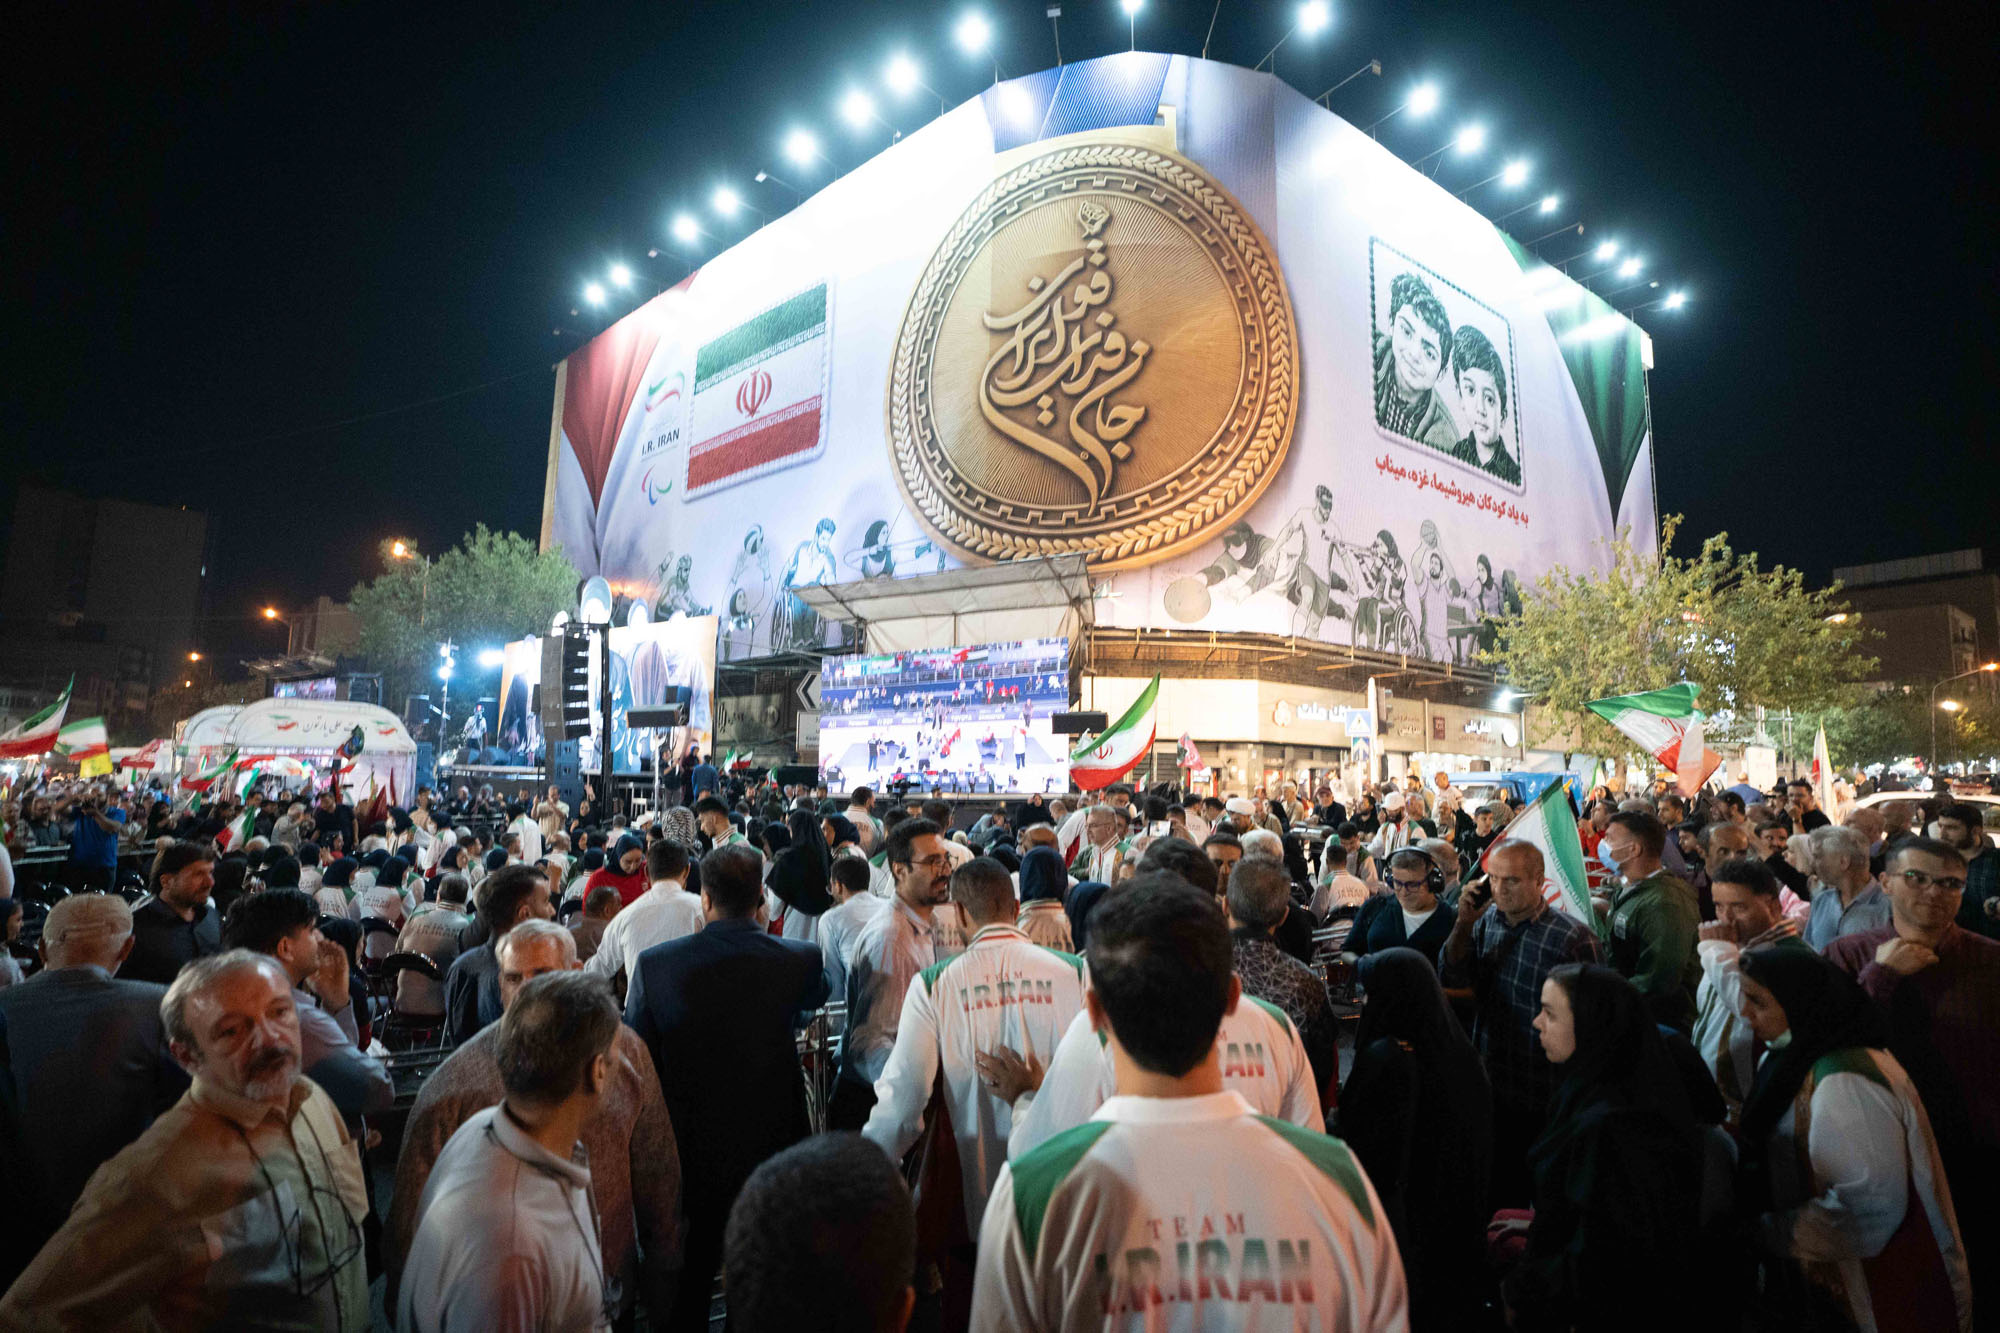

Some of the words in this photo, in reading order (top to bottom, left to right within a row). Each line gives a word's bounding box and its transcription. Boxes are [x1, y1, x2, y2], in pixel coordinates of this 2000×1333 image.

[641, 440, 655, 456] I.R.
[657, 427, 680, 449] IRAN
[1375, 453, 1407, 481] میناب
[1476, 493, 1507, 519] کودکان
[1507, 504, 1520, 525] یاد
[1520, 510, 1529, 528] به
[1146, 1213, 1247, 1240] TEAM
